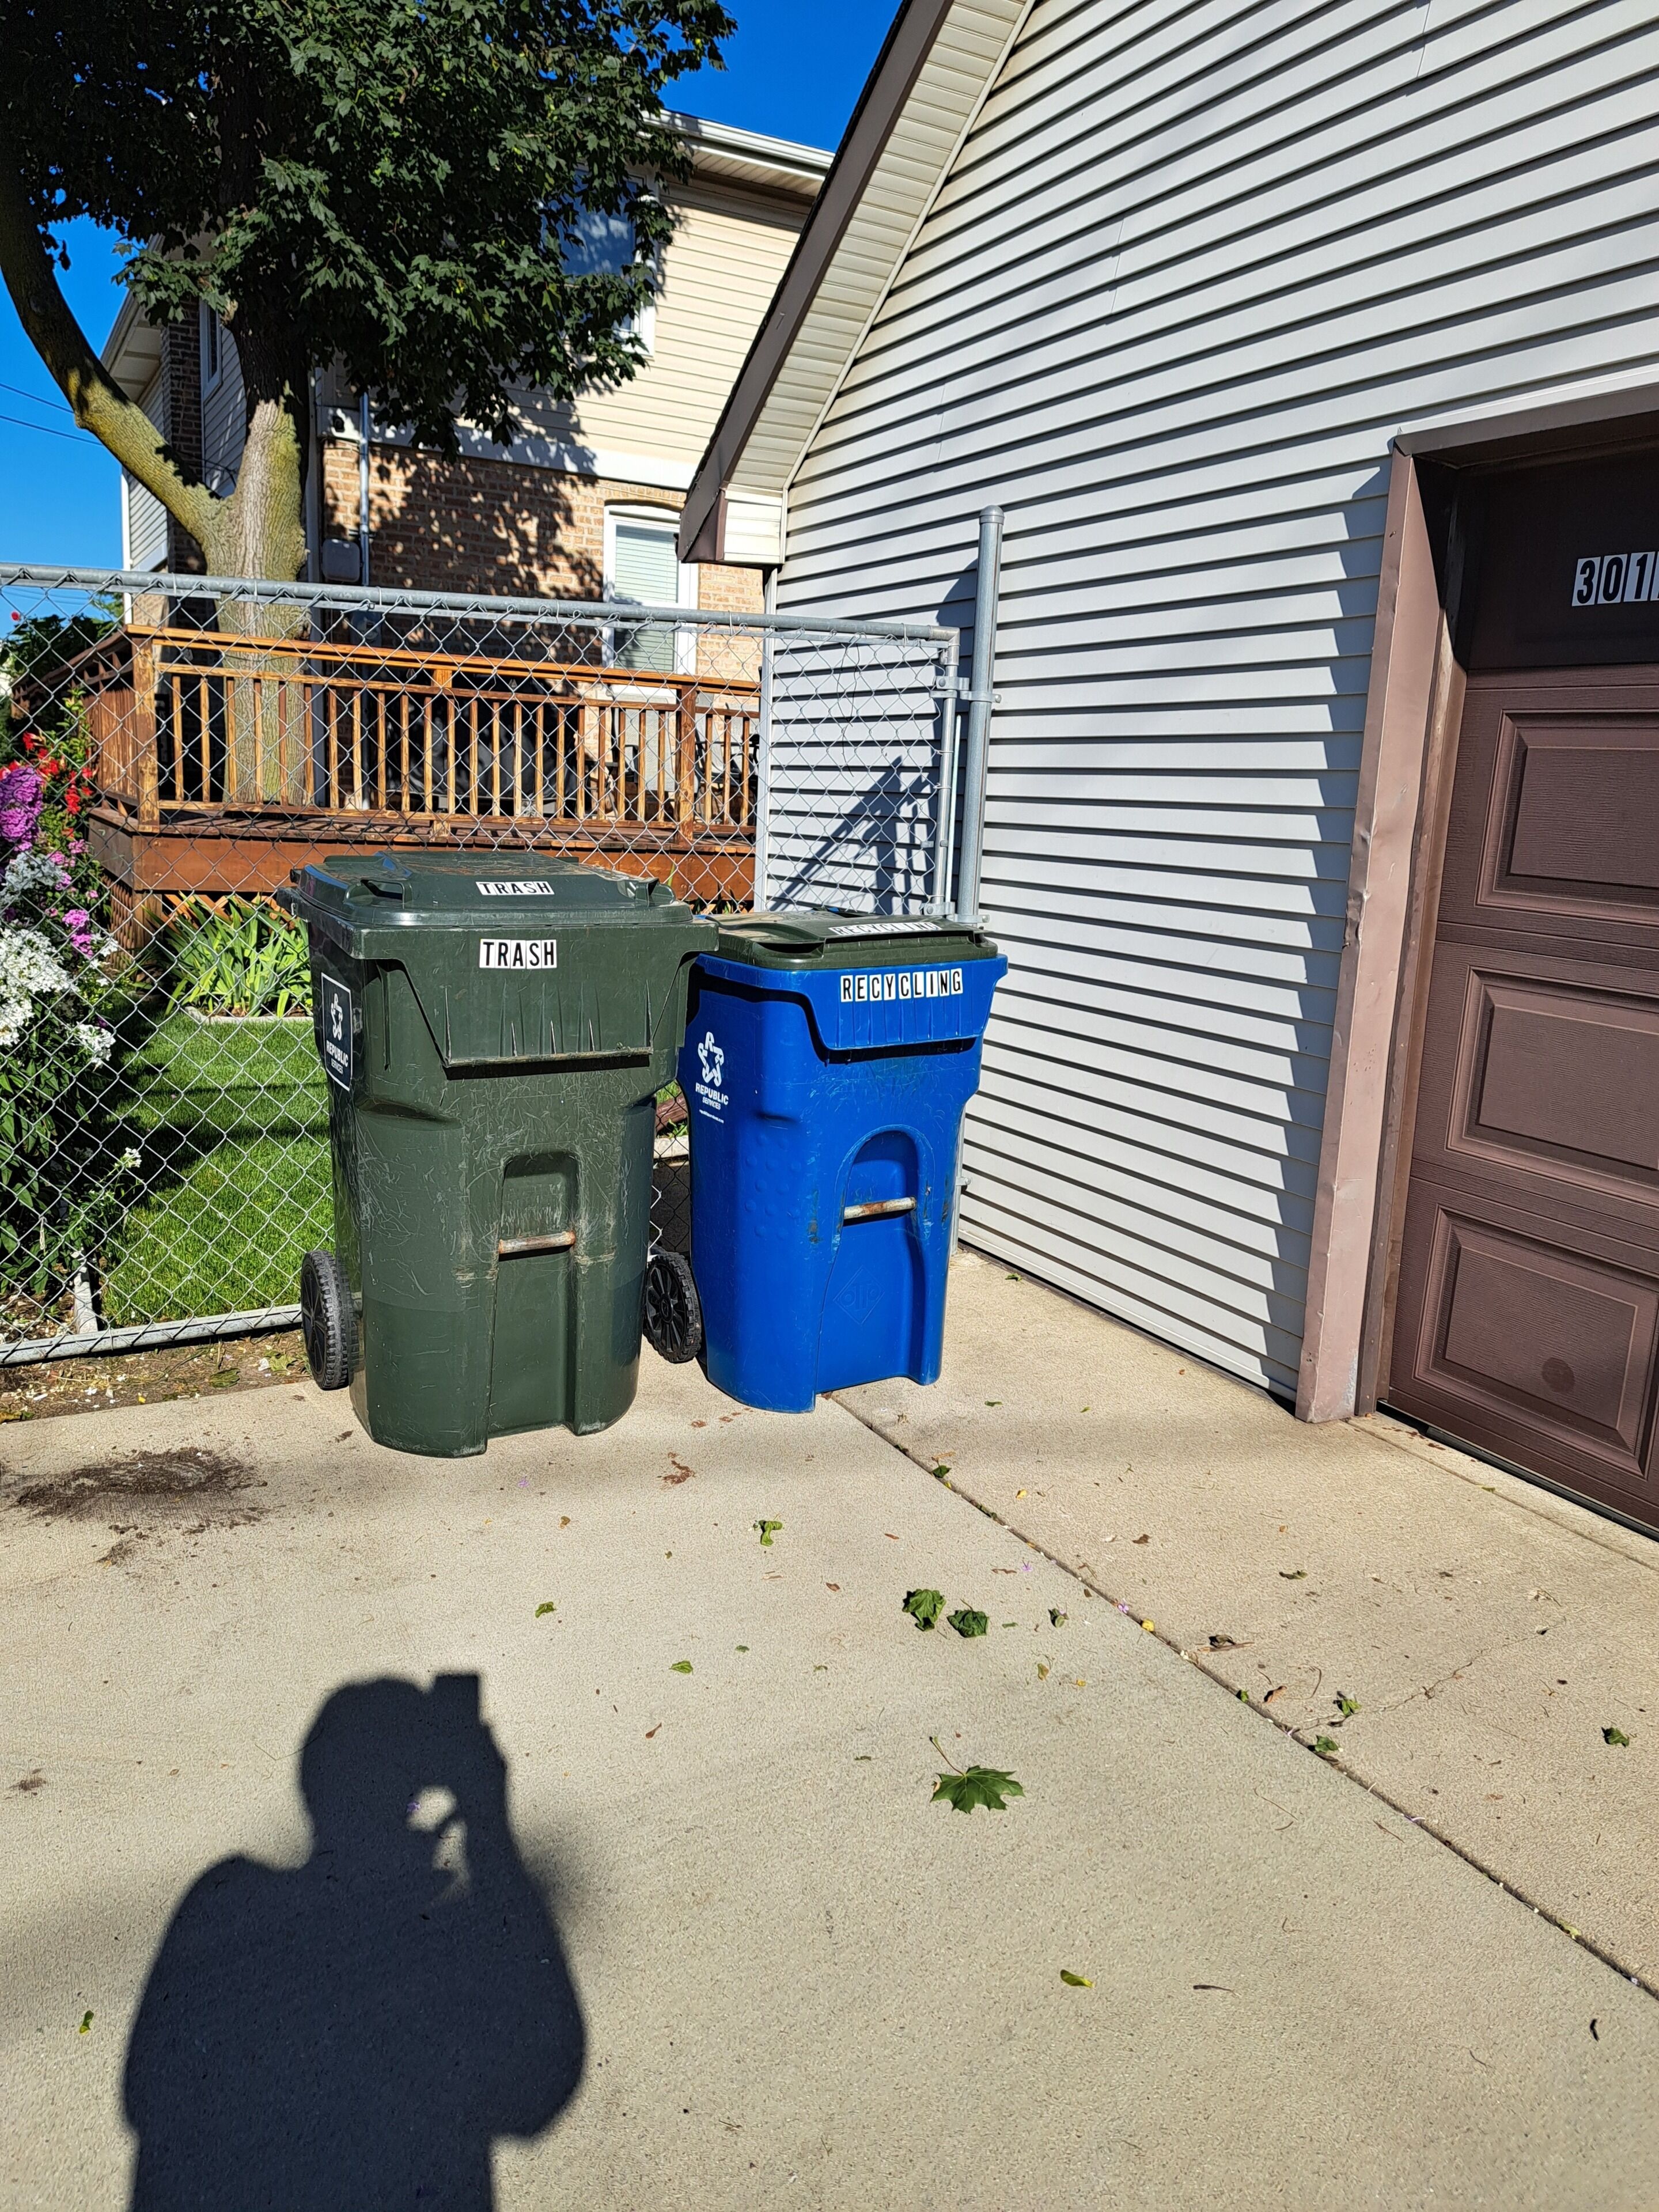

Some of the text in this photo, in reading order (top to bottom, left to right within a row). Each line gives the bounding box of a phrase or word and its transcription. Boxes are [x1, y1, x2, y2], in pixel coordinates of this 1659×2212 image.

[1577, 553, 1659, 604] 301
[479, 882, 551, 894] TRASH
[833, 922, 940, 935] RECYCLING
[483, 941, 554, 967] TRASH
[843, 971, 961, 1000] RECYCLING
[326, 1039, 349, 1067] REPUBLIC
[695, 1082, 729, 1105] REPUBLIC
